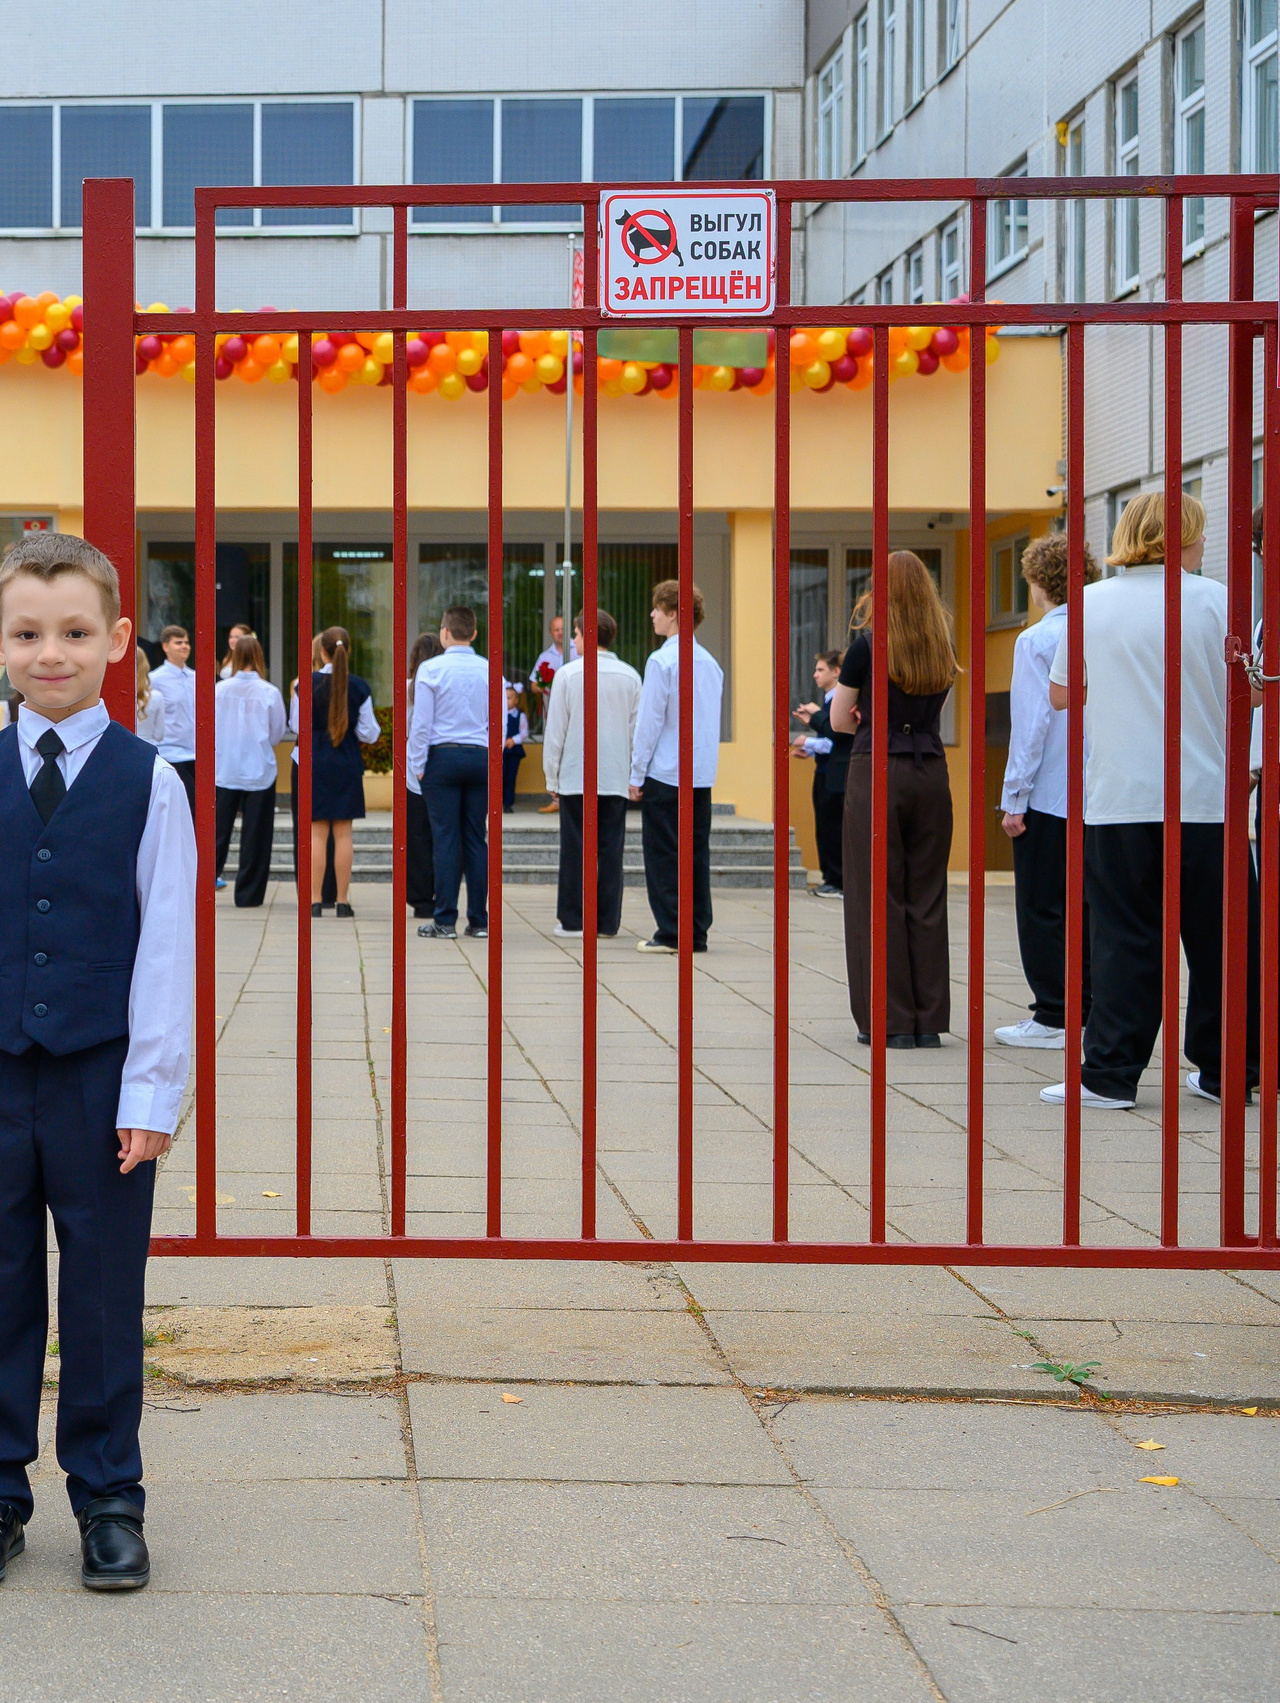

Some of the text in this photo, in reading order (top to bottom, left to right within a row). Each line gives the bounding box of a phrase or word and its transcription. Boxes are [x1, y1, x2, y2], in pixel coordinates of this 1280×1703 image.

[690, 213, 762, 232] ВЫГУЛ
[690, 240, 761, 260] СОБАК
[614, 270, 762, 304] ЗАПРЕЩЁН
